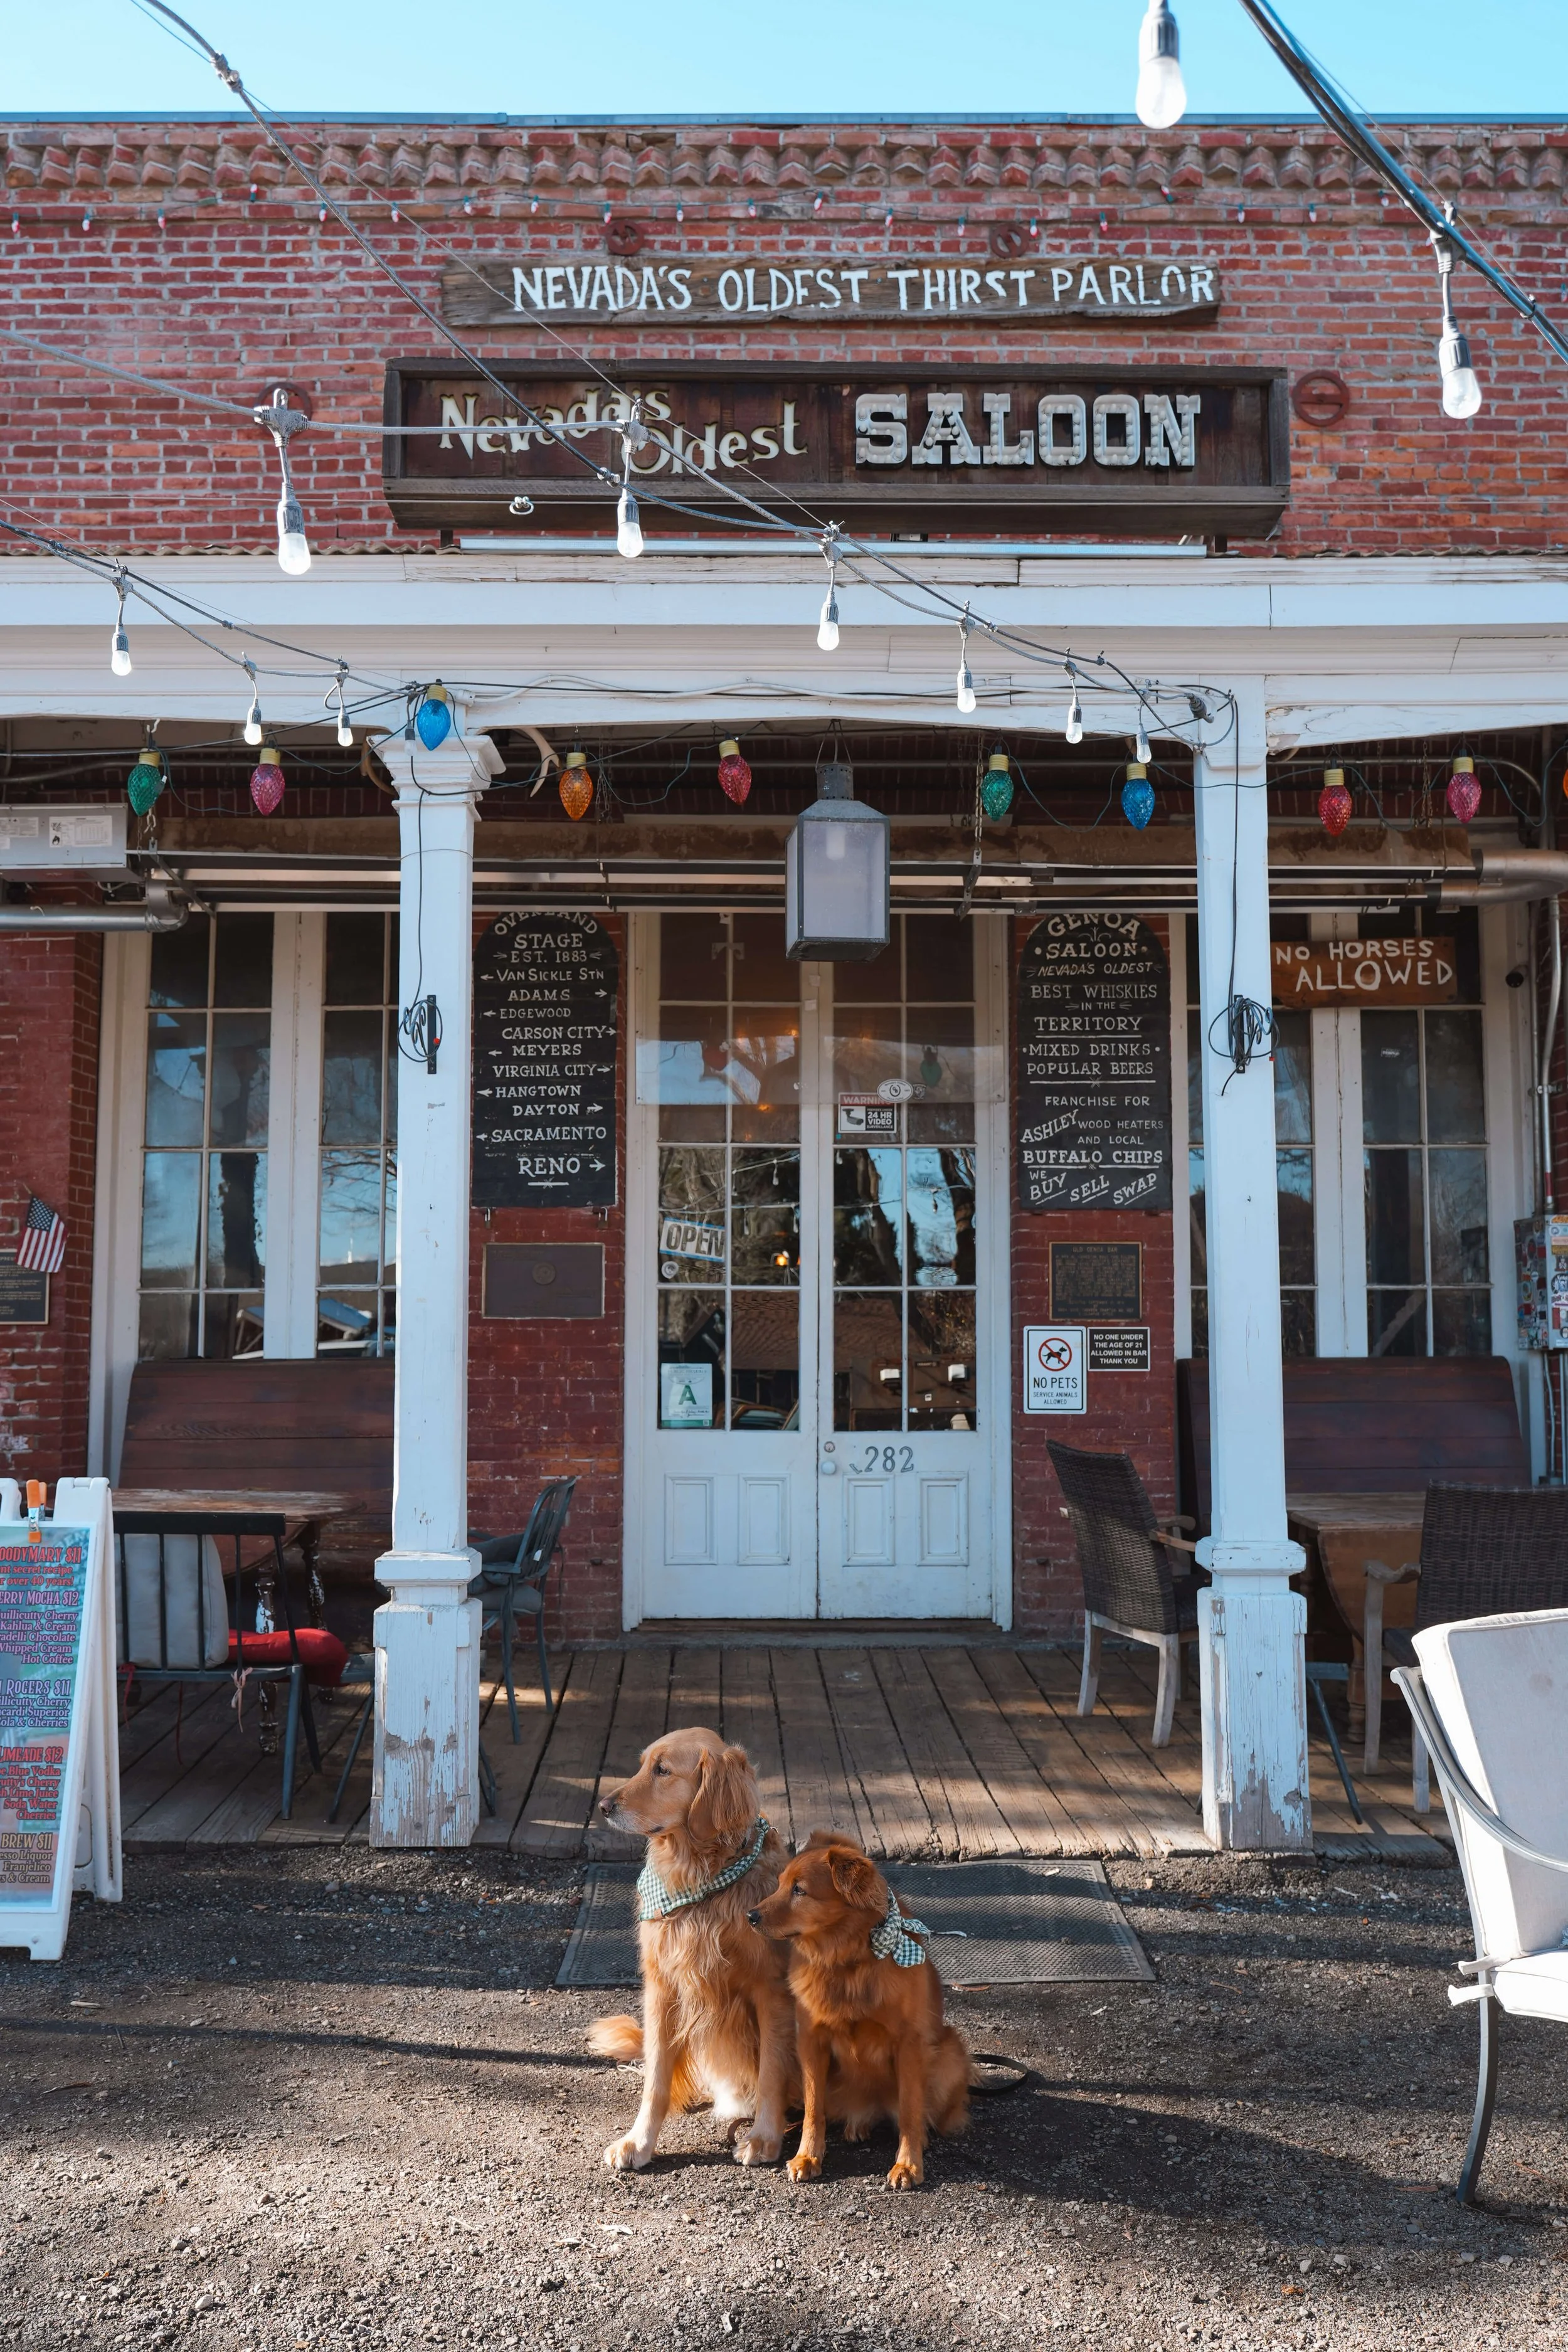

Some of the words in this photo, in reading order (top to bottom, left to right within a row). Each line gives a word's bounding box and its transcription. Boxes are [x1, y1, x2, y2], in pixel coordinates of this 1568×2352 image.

[512, 266, 692, 311] NEVADA'S
[717, 268, 868, 312] OLDEST
[887, 268, 1035, 310] THIRST
[1051, 265, 1214, 304] PARLOR
[439, 388, 670, 459] Nevada's
[620, 400, 808, 475] Oldest
[855, 393, 1201, 467] SALOON
[1047, 914, 1140, 940] GENOA
[514, 933, 583, 949] STAGE
[511, 951, 547, 963] EST.
[556, 950, 587, 963] 1883
[1046, 943, 1138, 959] SALOON
[1276, 946, 1310, 965] NO
[1329, 940, 1434, 960] HORSES
[1038, 963, 1094, 977] NEVADA'S
[1104, 962, 1153, 973] OLDEST
[1296, 959, 1453, 992] ALLOWED
[508, 989, 570, 1001] ADAMS
[1030, 985, 1072, 999] BEST
[1083, 985, 1157, 999] WHISKIES
[1081, 1002, 1092, 1010] IN
[500, 1008, 571, 1019] EDGEWOOD
[1034, 1017, 1142, 1030] TERRITORY
[502, 1027, 563, 1039] CARSON
[568, 1025, 607, 1039] CITY
[512, 1044, 581, 1056] MEYERS
[1029, 1044, 1079, 1056] MIXED
[1090, 1044, 1150, 1056] DRINKS
[492, 1065, 560, 1077] VIRGINIA
[564, 1064, 596, 1076] CITY
[1027, 1062, 1101, 1074] POPULAR
[1110, 1062, 1153, 1074] BEERS
[495, 1086, 581, 1098] HANGTOWN
[843, 1096, 891, 1104] WARNIN
[1046, 1096, 1116, 1106] FRANCHISE
[1125, 1096, 1150, 1106] FOR
[512, 1104, 580, 1116] DAYTON
[1020, 1109, 1079, 1143] ASHLEY
[1078, 1120, 1111, 1129] WOOD
[1118, 1120, 1163, 1129] HEATERS
[492, 1126, 607, 1142] SACRAMENTO
[1078, 1136, 1100, 1144] AND
[1110, 1136, 1144, 1145] LOCAL
[1023, 1150, 1102, 1163] BUFFALO
[1113, 1150, 1162, 1163] CHIPS
[517, 1157, 581, 1177] RENO
[1029, 1170, 1046, 1180] WE
[1030, 1172, 1067, 1200] BUY
[1070, 1175, 1110, 1202] SELL
[1113, 1173, 1157, 1204] SWAP
[666, 1223, 725, 1257] OPEN
[1034, 1377, 1047, 1388] NO
[1051, 1377, 1078, 1389] PETS
[679, 1385, 697, 1405] A
[65, 1546, 82, 1564] $11
[43, 1564, 73, 1577] recipe
[31, 1576, 45, 1586] 40
[46, 1576, 74, 1589] years!
[26, 1591, 60, 1605] MOCHA
[63, 1591, 80, 1606] $12
[45, 1610, 78, 1622] Cherry
[1, 1621, 33, 1631] Kahlua
[35, 1621, 43, 1631] &
[45, 1621, 76, 1631] Cream
[29, 1632, 75, 1642] Chocolate
[40, 1643, 72, 1653] Cream
[22, 1655, 41, 1663] Hot
[42, 1655, 73, 1664] Coffee
[6, 1678, 50, 1697] ROGERS
[55, 1680, 71, 1696] $11
[37, 1696, 70, 1708] Cherry
[28, 1707, 69, 1718] Superior
[0, 1717, 15, 1727] ola
[17, 1718, 26, 1727] &
[28, 1718, 68, 1727] Cherries
[45, 1746, 63, 1763] $12
[8, 1765, 30, 1776] Blue
[31, 1766, 61, 1776] Vodka
[27, 1777, 60, 1789] Cherry
[9, 1788, 34, 1797] Lime
[35, 1788, 58, 1799] Juice
[4, 1798, 26, 1809] Soda
[29, 1799, 58, 1809] Water
[16, 1809, 56, 1820] Cherries
[1, 1833, 36, 1849] BREW
[37, 1833, 53, 1850] $11
[19, 1850, 53, 1862] Liquor
[3, 1861, 51, 1873] Franjelico
[8, 1873, 17, 1883] &
[18, 1873, 50, 1883] Cream
